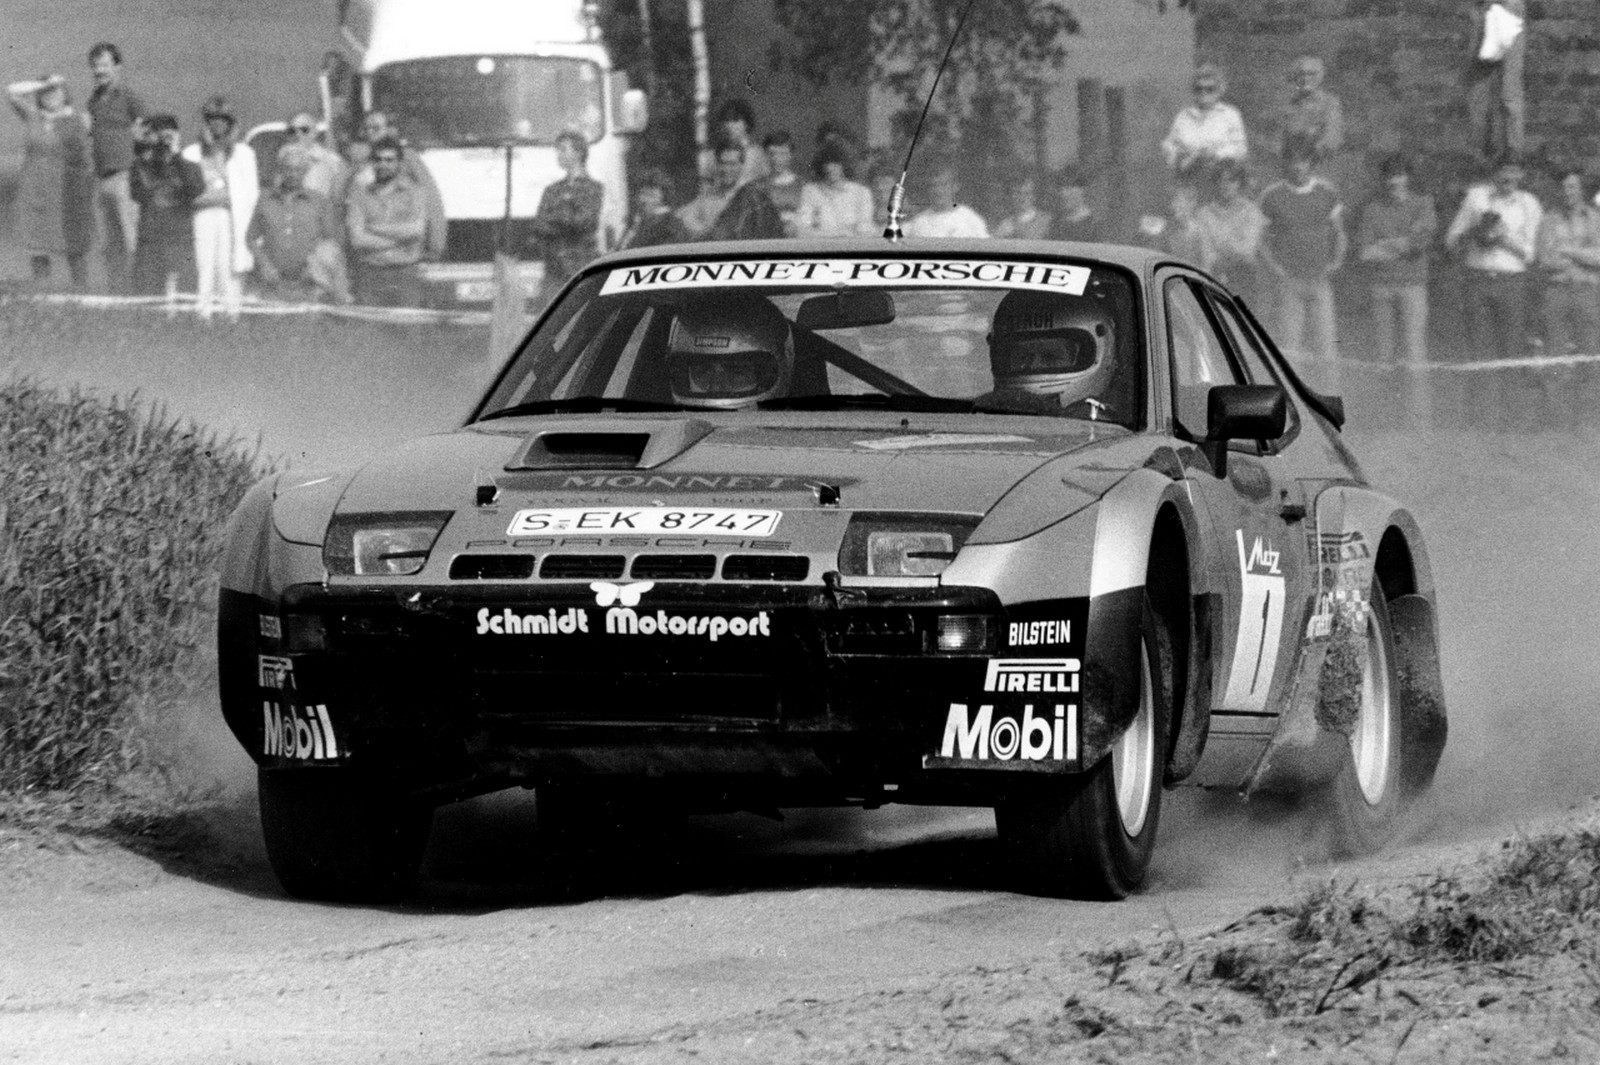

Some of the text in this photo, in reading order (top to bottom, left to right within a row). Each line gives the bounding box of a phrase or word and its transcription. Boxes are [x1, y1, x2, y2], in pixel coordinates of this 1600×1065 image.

[561, 475, 788, 488] MONNET
[659, 511, 770, 531] 8747
[464, 537, 793, 551] PORSCHE
[476, 607, 770, 642] Schmidt Motorsport
[1008, 619, 1071, 646] BILSTEIN
[983, 658, 1081, 692] PIRELLI
[263, 700, 339, 760] Mobil
[940, 703, 1078, 761] Mobil
